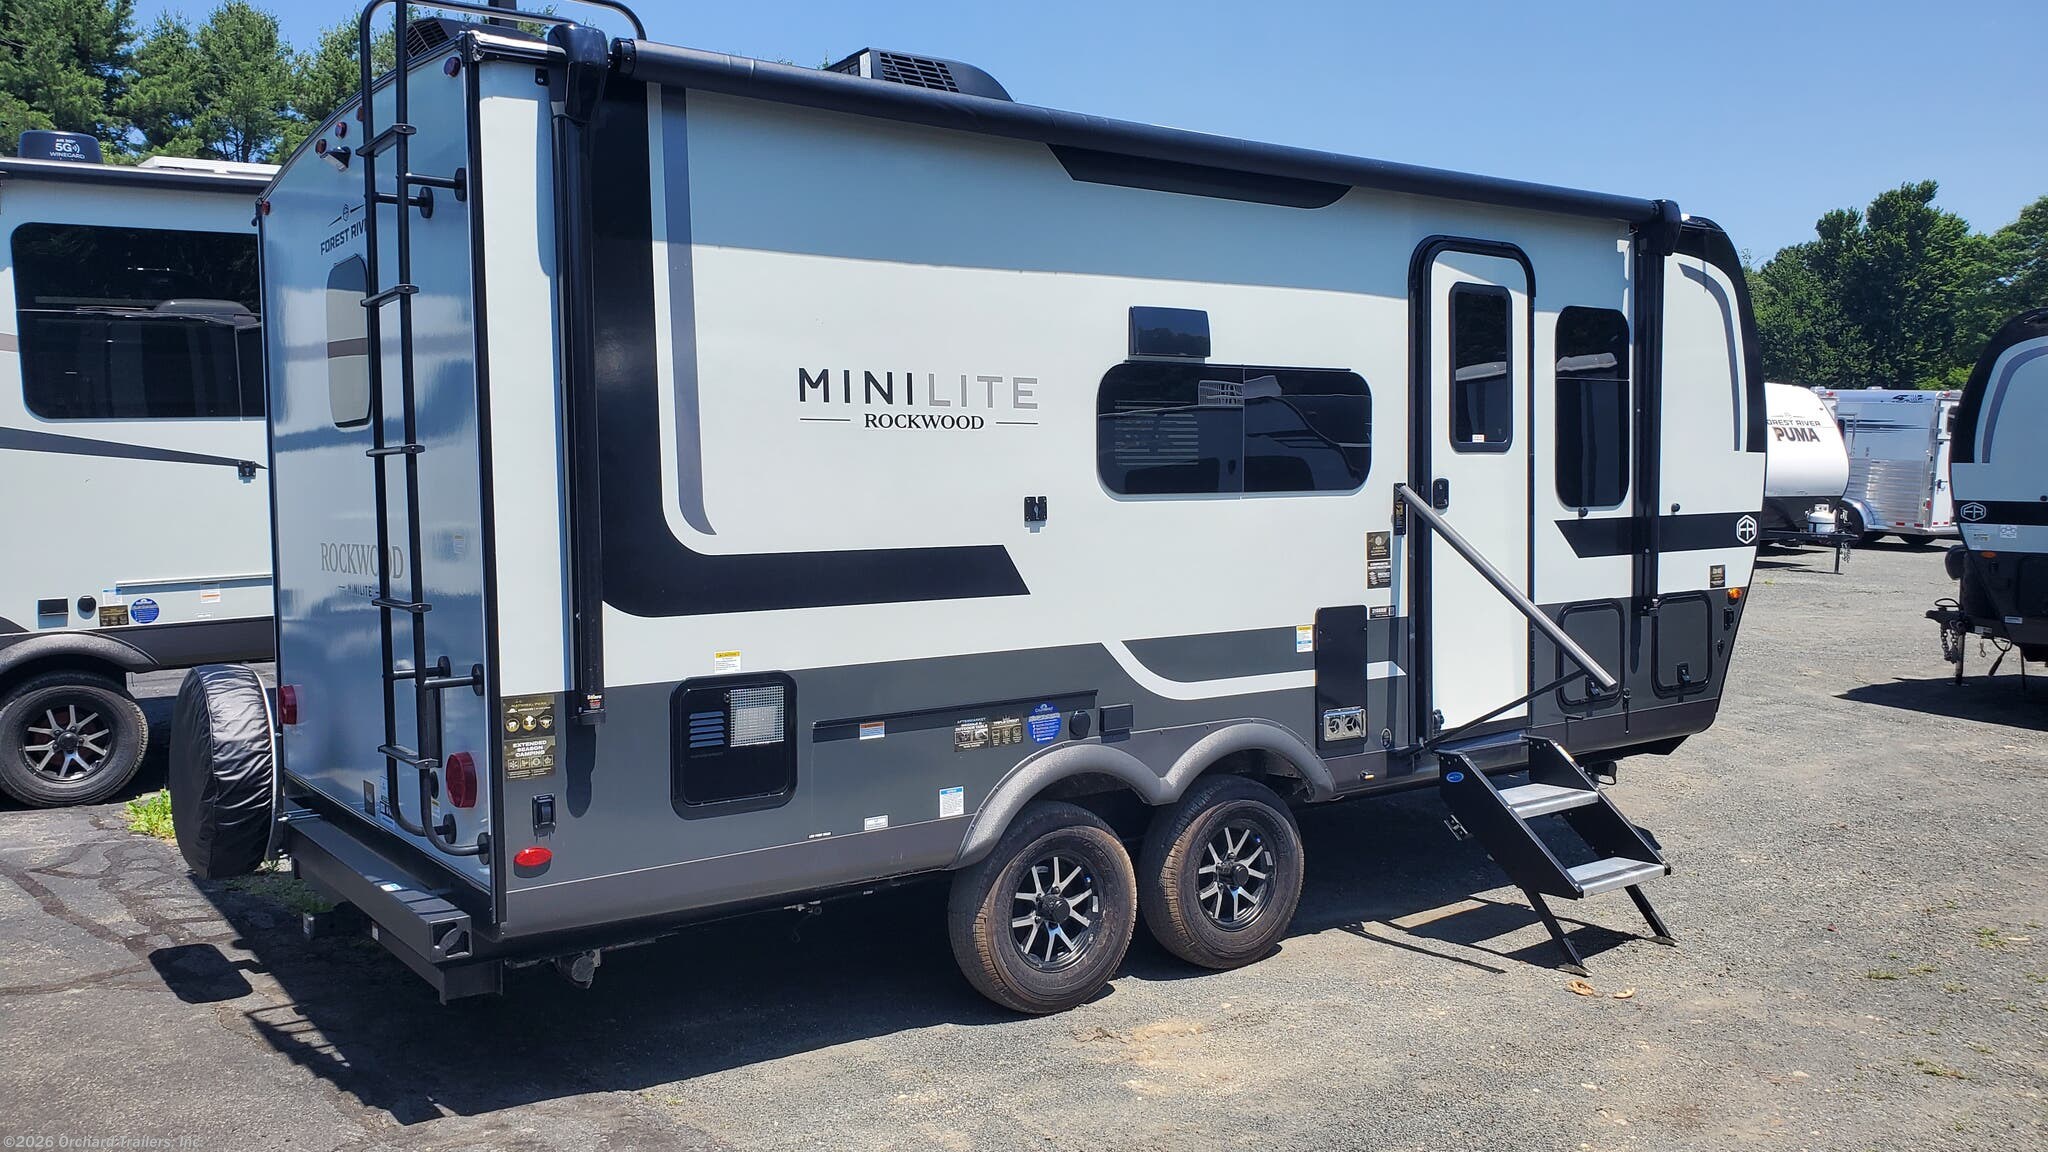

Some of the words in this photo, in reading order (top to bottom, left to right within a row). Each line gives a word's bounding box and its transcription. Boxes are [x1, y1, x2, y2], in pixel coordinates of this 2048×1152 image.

[55, 143, 72, 152] 5G
[49, 151, 86, 159] WINEGARD
[320, 228, 349, 255] FOREST
[350, 218, 367, 239] RIV
[798, 367, 1038, 410] MINILITE
[864, 413, 985, 430] ROCKWOOD
[1766, 418, 1794, 426] OREST
[1772, 427, 1821, 442] PUMA
[512, 740, 547, 748] EXTENDED
